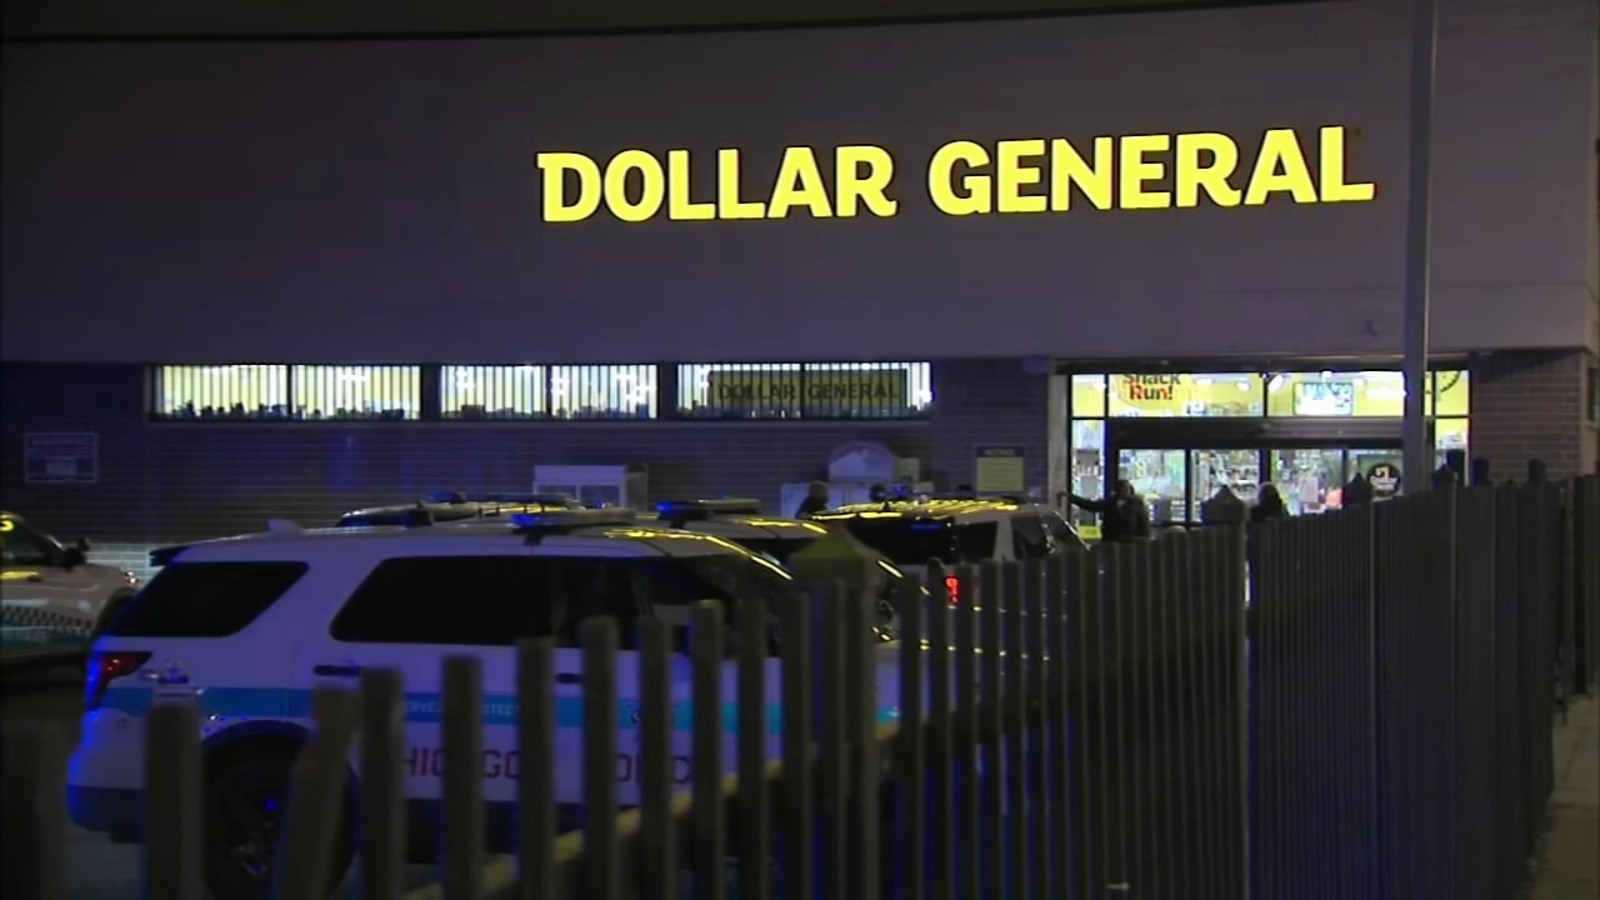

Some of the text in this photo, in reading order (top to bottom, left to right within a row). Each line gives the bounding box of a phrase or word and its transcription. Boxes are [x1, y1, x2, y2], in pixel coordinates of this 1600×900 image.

[538, 126, 1376, 222] DOLLAR GENERAL
[719, 382, 898, 400] DOLLAR GENERAL
[1129, 385, 1173, 400] Run!
